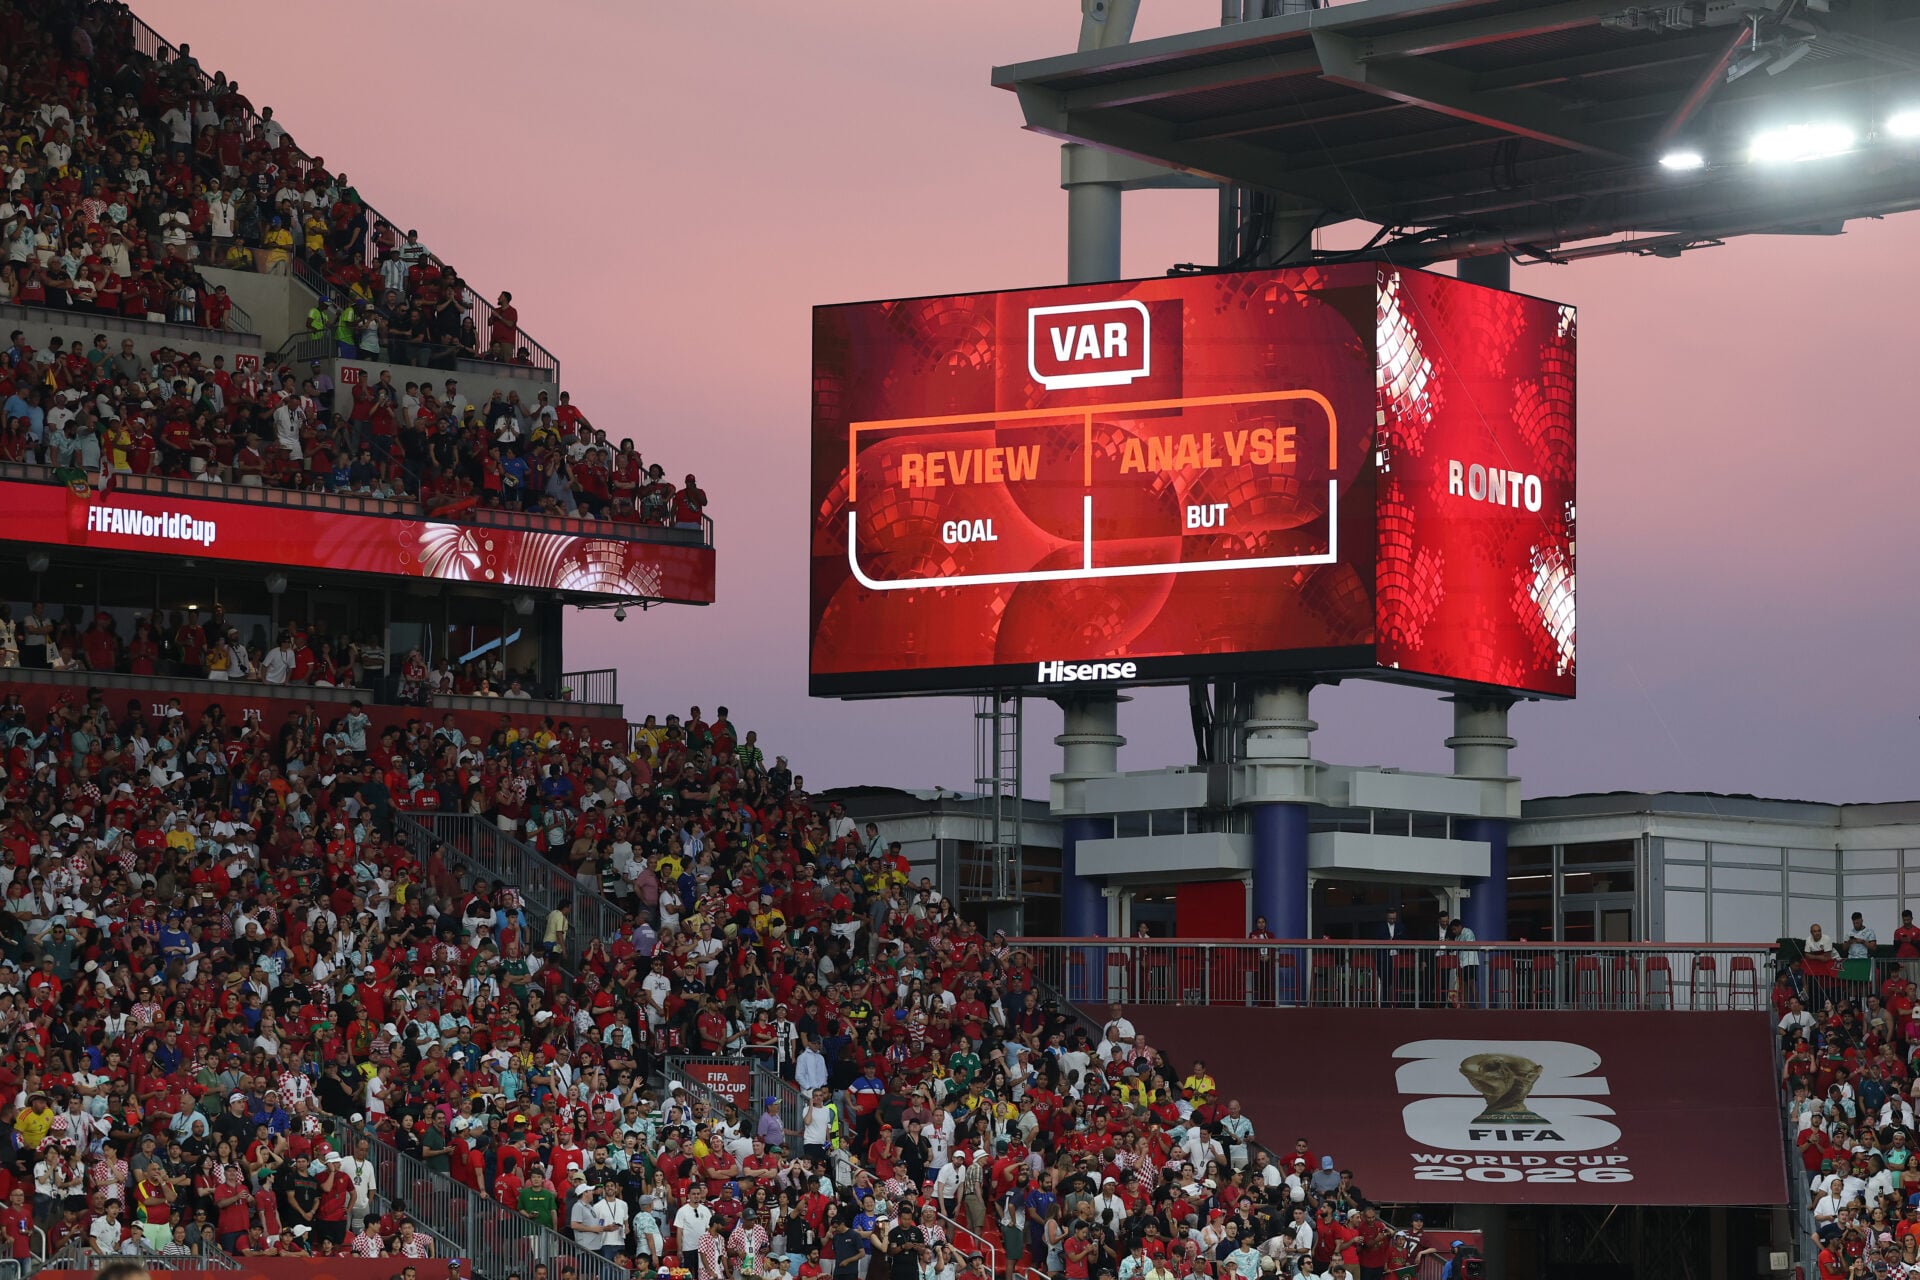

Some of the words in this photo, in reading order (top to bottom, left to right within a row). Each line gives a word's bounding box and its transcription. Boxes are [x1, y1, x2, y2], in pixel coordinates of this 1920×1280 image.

[1049, 321, 1128, 363] VAR
[1119, 426, 1297, 475] ANALYSE
[900, 445, 1041, 489] REVIEW
[1448, 459, 1543, 512] RONTO
[87, 505, 216, 547] FIFAWorldCup
[1186, 503, 1229, 529] BUT
[942, 518, 998, 544] GOAL
[1037, 659, 1137, 684] Hisense
[708, 1072, 728, 1081] FIFA
[727, 1083, 746, 1093] CUP
[1468, 1129, 1565, 1141] FIFA
[1409, 1153, 1547, 1166] WORLD
[1554, 1155, 1629, 1166] CUP
[1412, 1166, 1634, 1183] 2026
